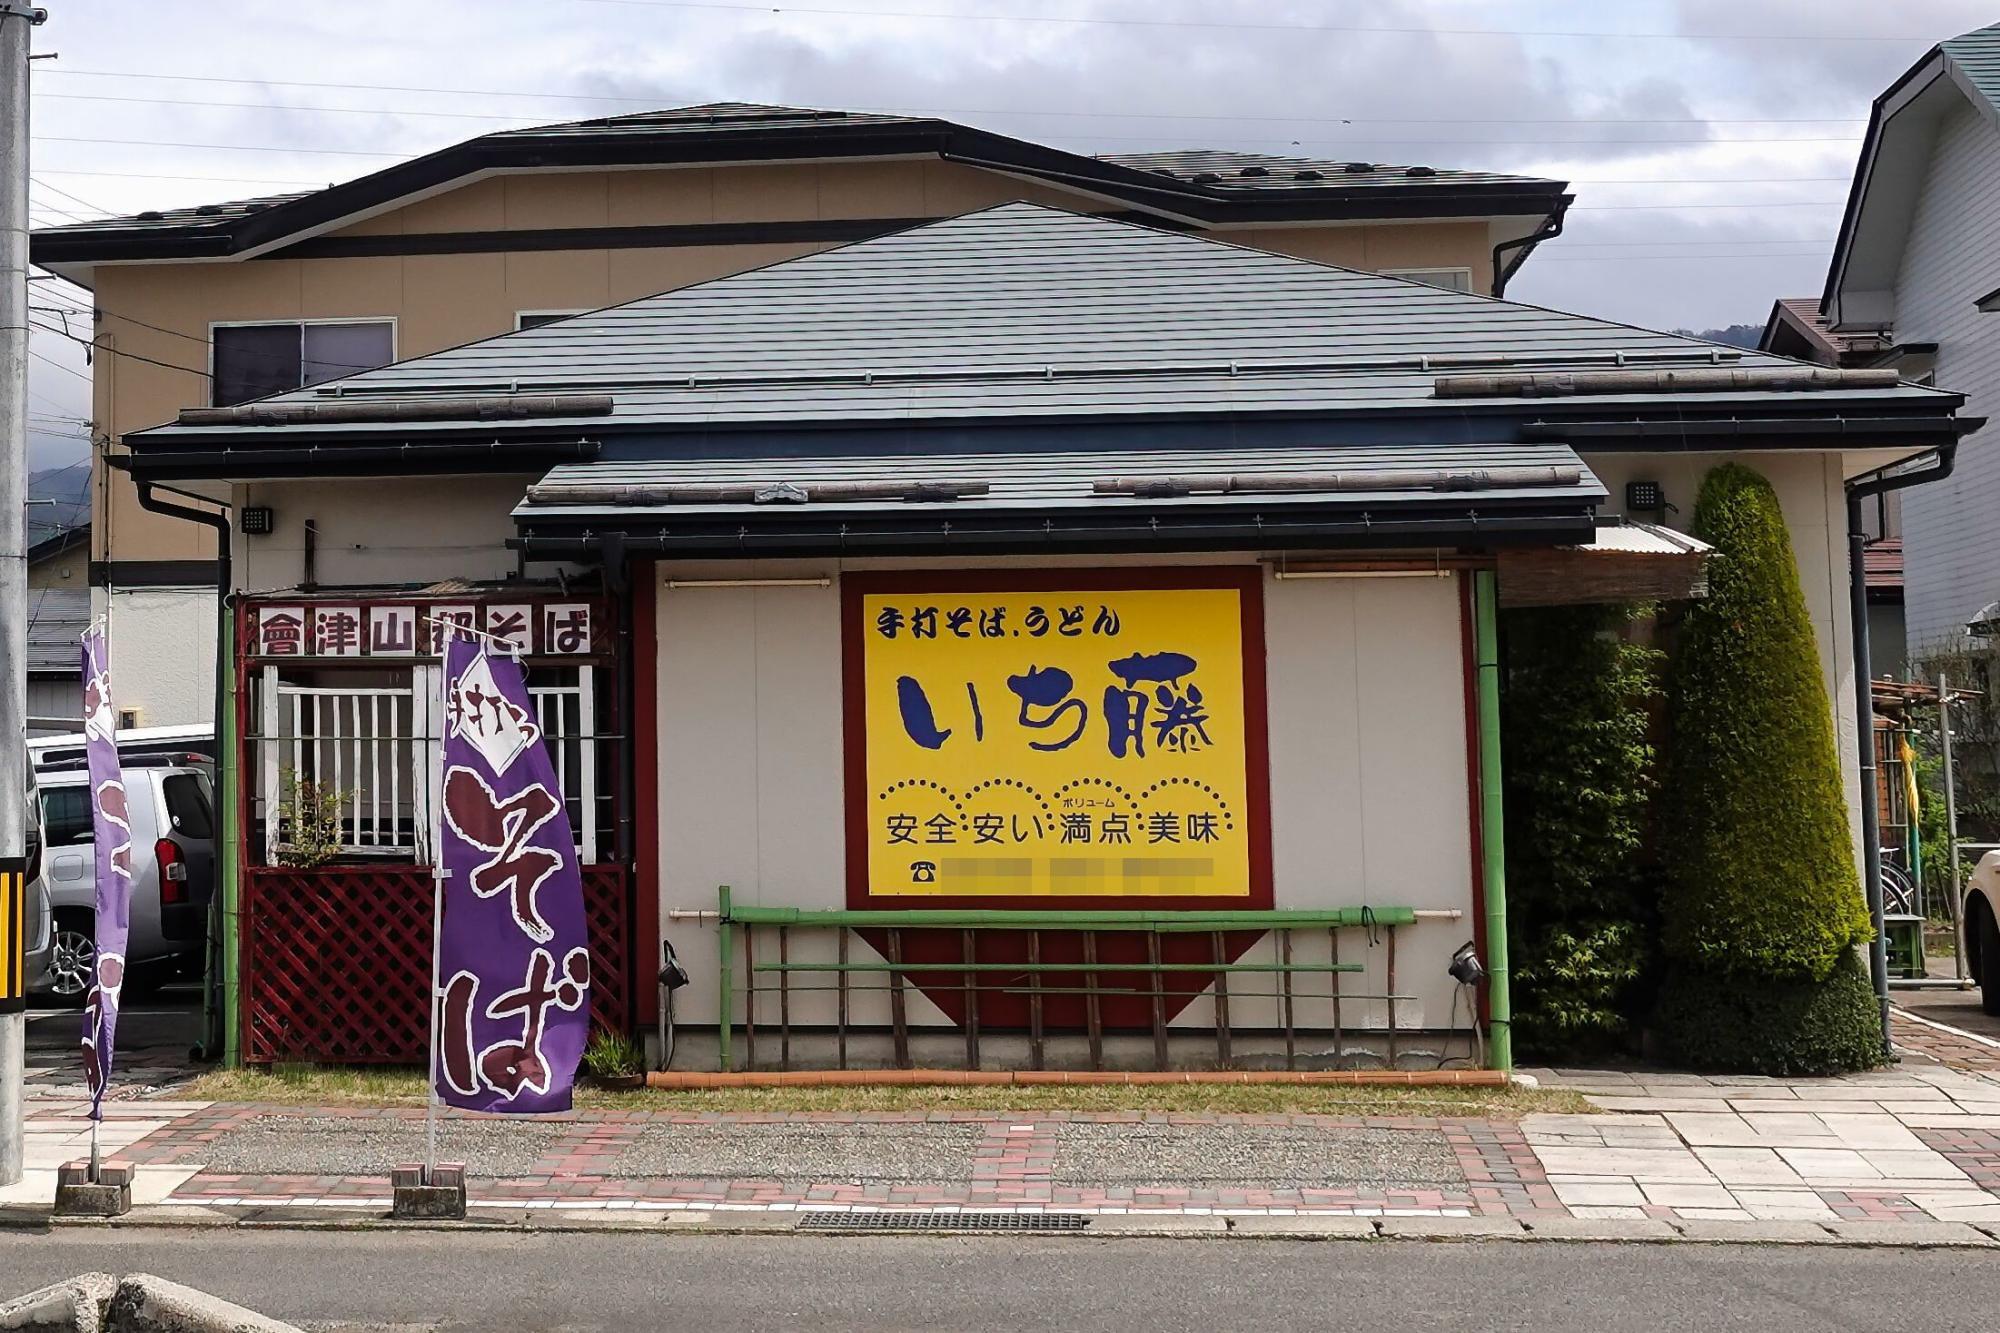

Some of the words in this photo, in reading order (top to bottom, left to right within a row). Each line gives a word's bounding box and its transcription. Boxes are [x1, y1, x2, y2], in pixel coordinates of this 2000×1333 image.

[896, 651, 1214, 759] いち藤
[1062, 797, 1116, 809] ボリューム
[441, 764, 590, 1101] そば
